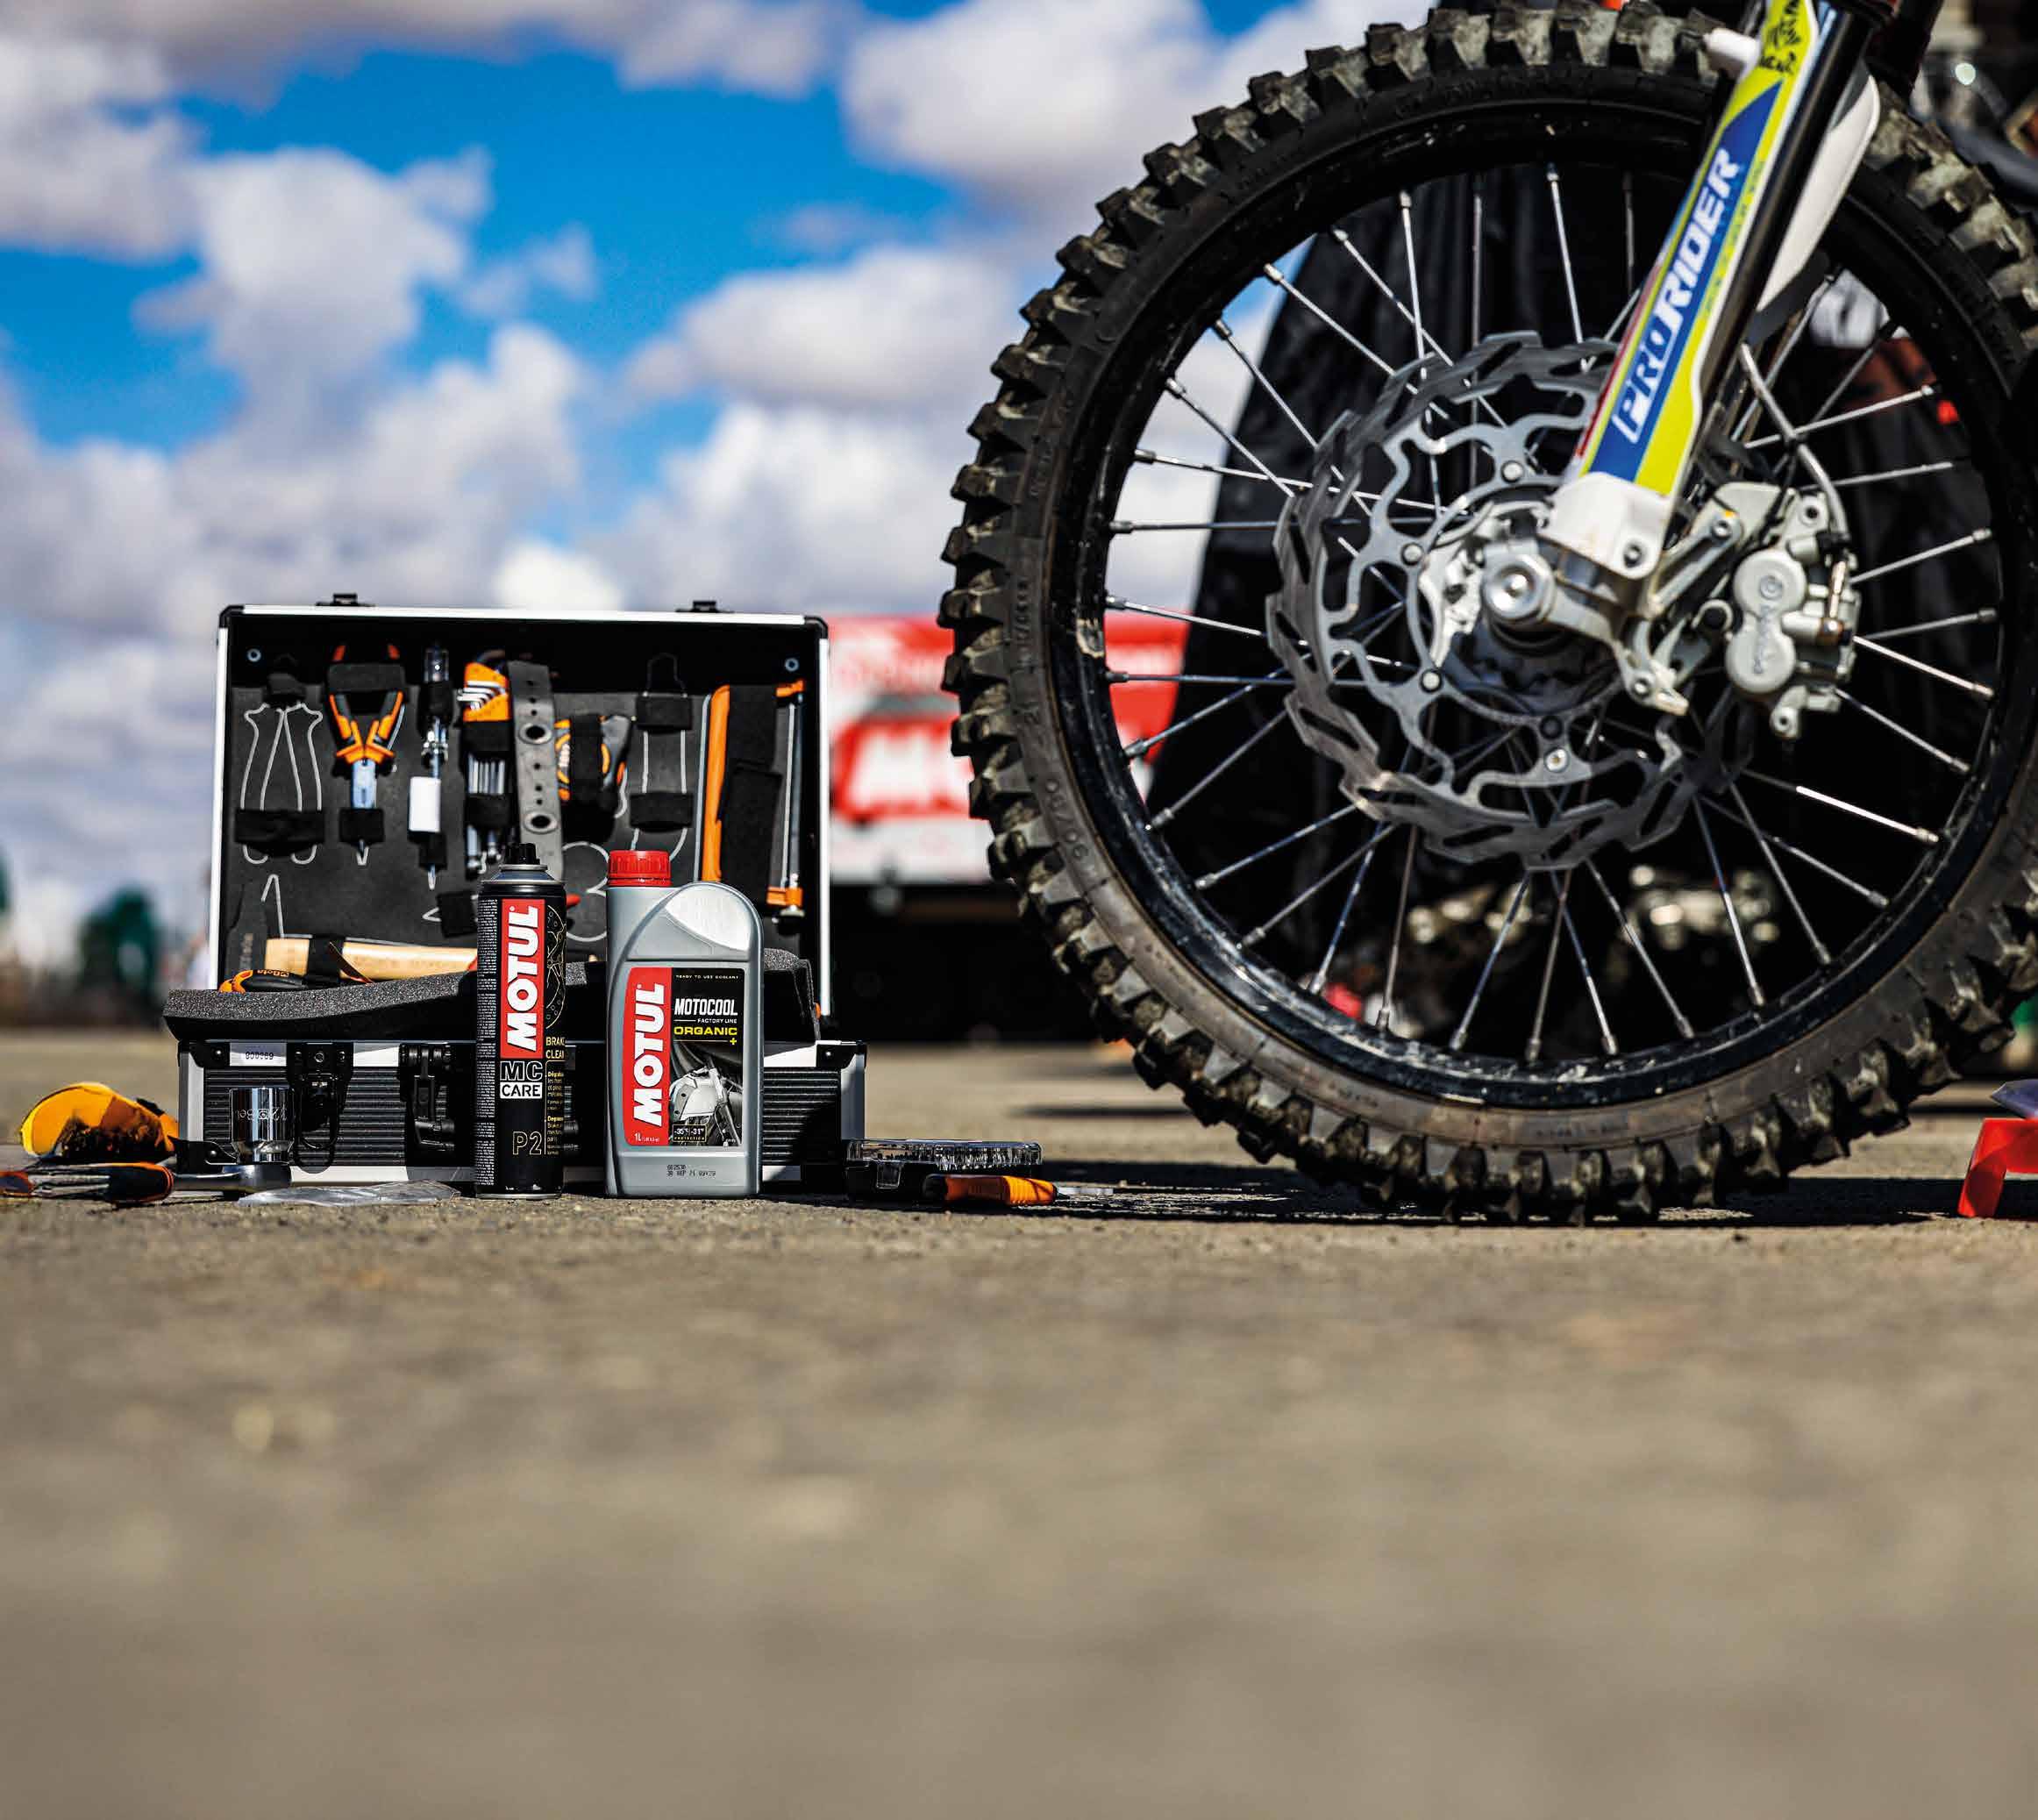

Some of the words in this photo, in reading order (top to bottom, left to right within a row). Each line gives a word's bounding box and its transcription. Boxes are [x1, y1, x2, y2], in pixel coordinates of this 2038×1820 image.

[1612, 148, 1739, 443] PRORIDER
[507, 906, 538, 1052] MOTUL
[674, 998, 738, 1016] MOTOCOOL
[673, 1026, 738, 1036] ORGANIC
[545, 1037, 566, 1046] BRAK
[545, 1050, 565, 1059] CLEA
[633, 983, 664, 1126] MOTUL
[500, 1060, 543, 1081] MC
[502, 1084, 541, 1097] CARE
[512, 1131, 542, 1155] P2
